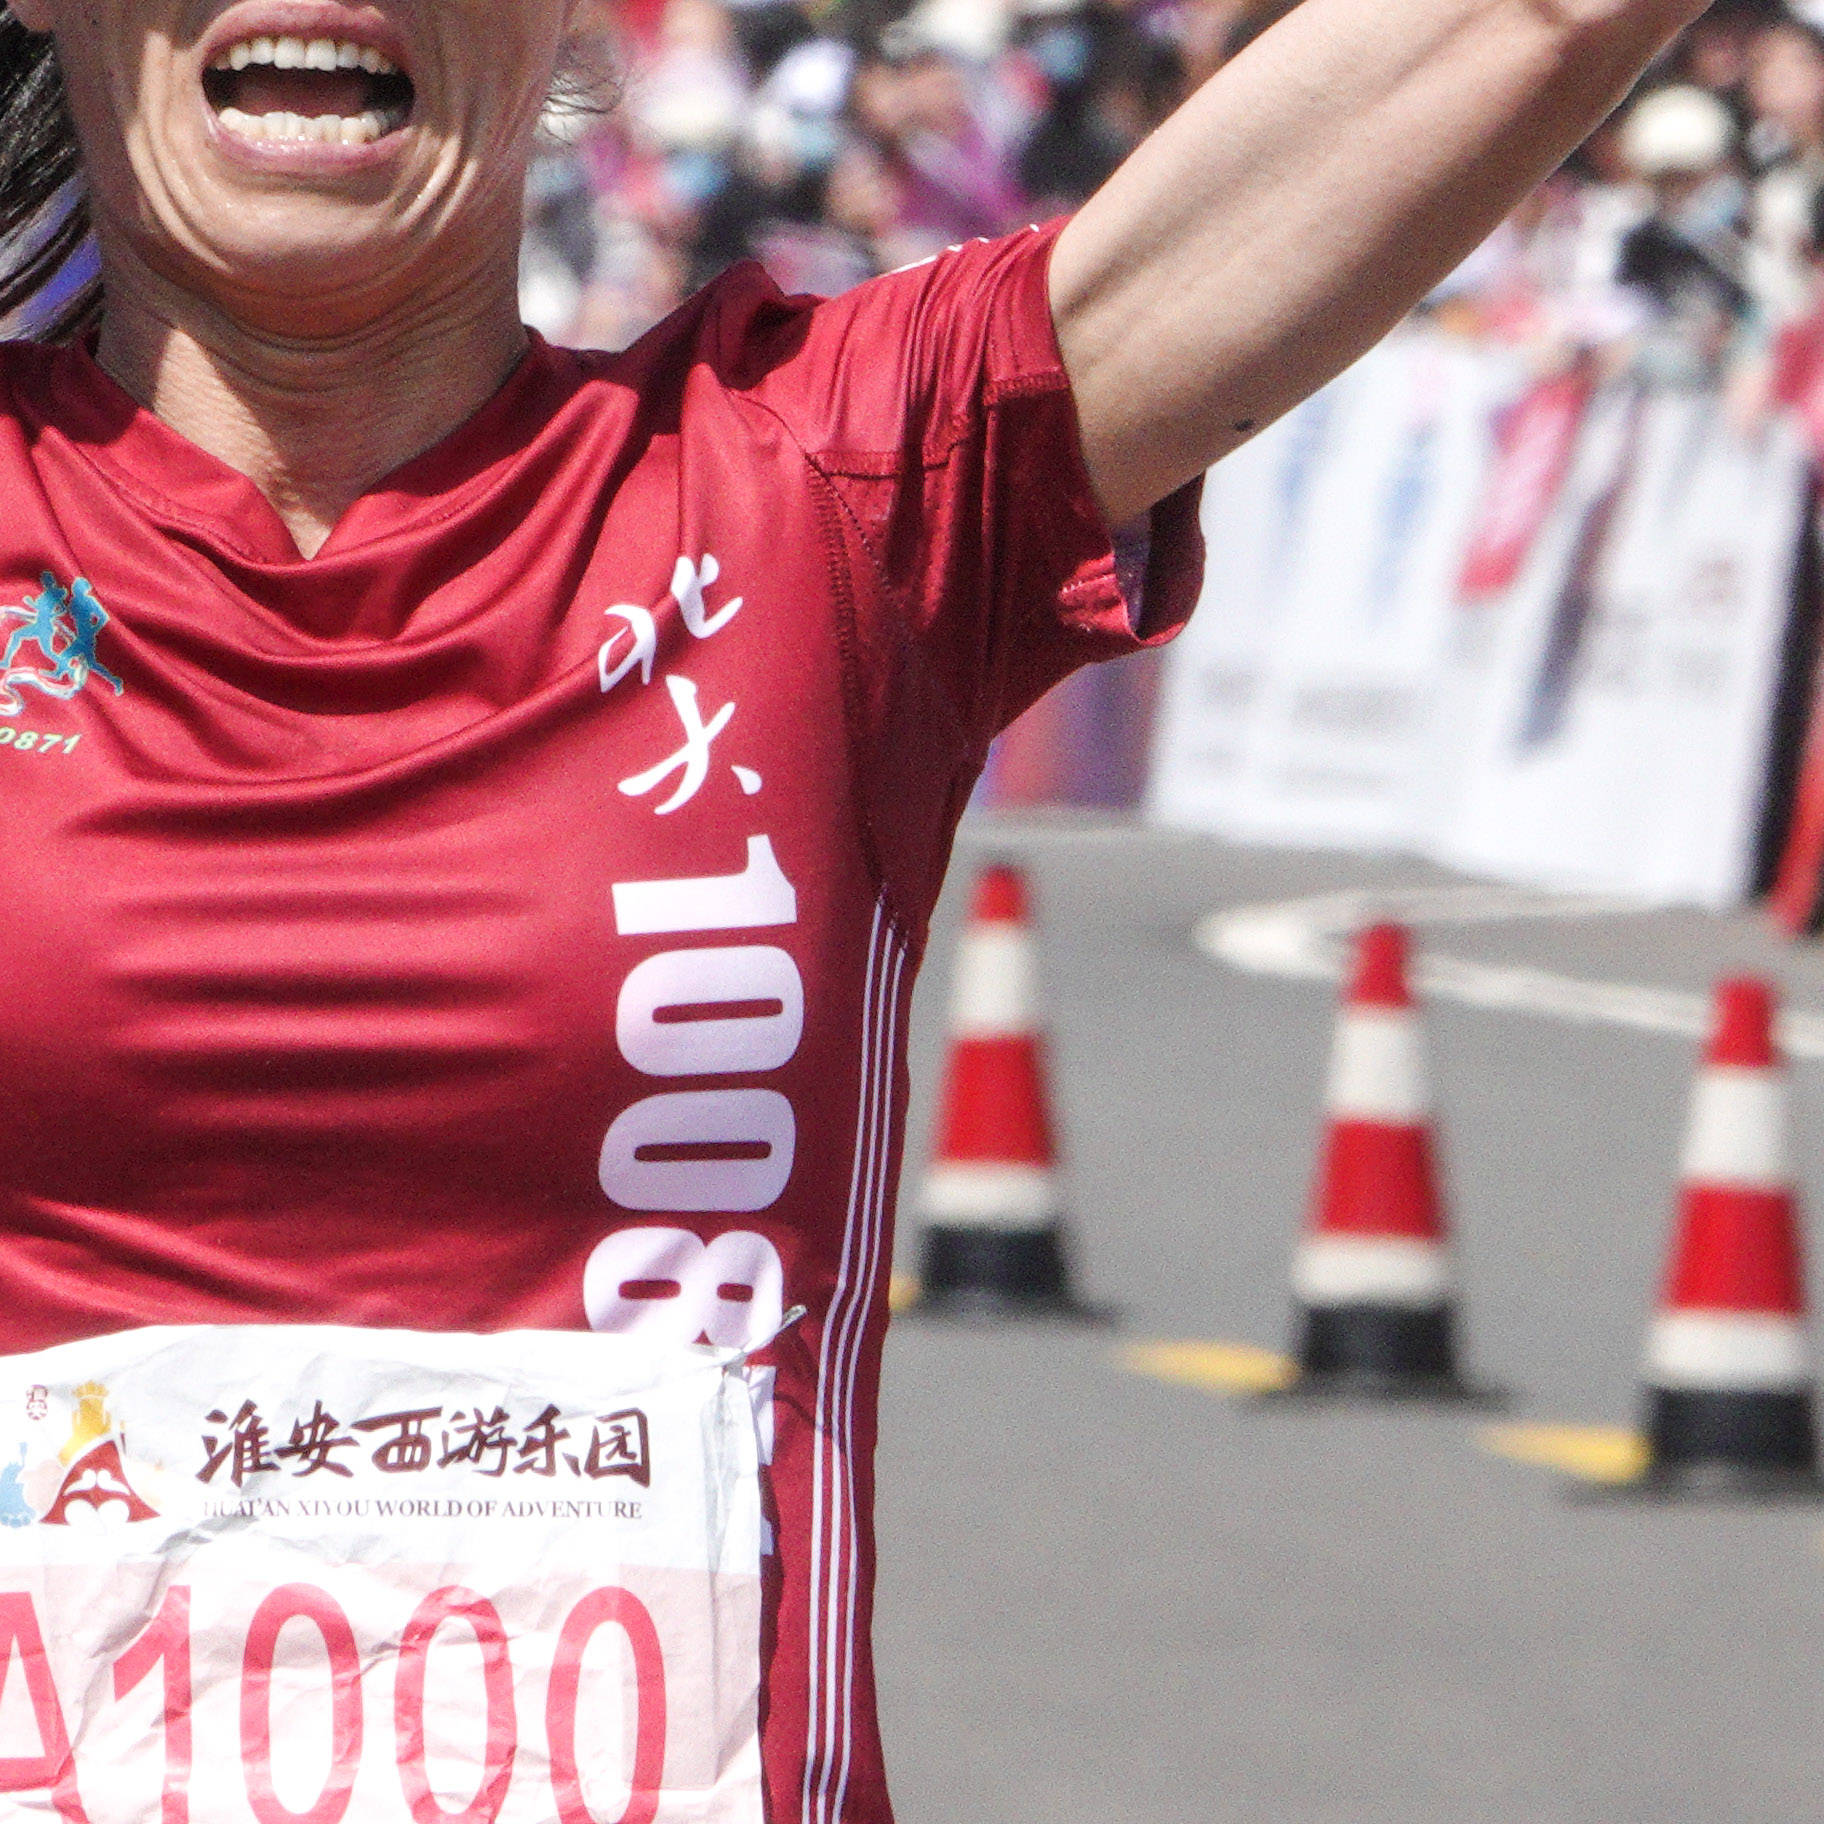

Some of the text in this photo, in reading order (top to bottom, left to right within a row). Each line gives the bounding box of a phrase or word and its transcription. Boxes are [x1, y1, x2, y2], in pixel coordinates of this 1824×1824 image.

[582, 834, 805, 1556] 1008
[195, 1398, 651, 1489] 淮安西游乐园
[375, 1499, 463, 1518] WORLD
[466, 1499, 498, 1518] OF
[502, 1500, 643, 1519] ADVENTURE
